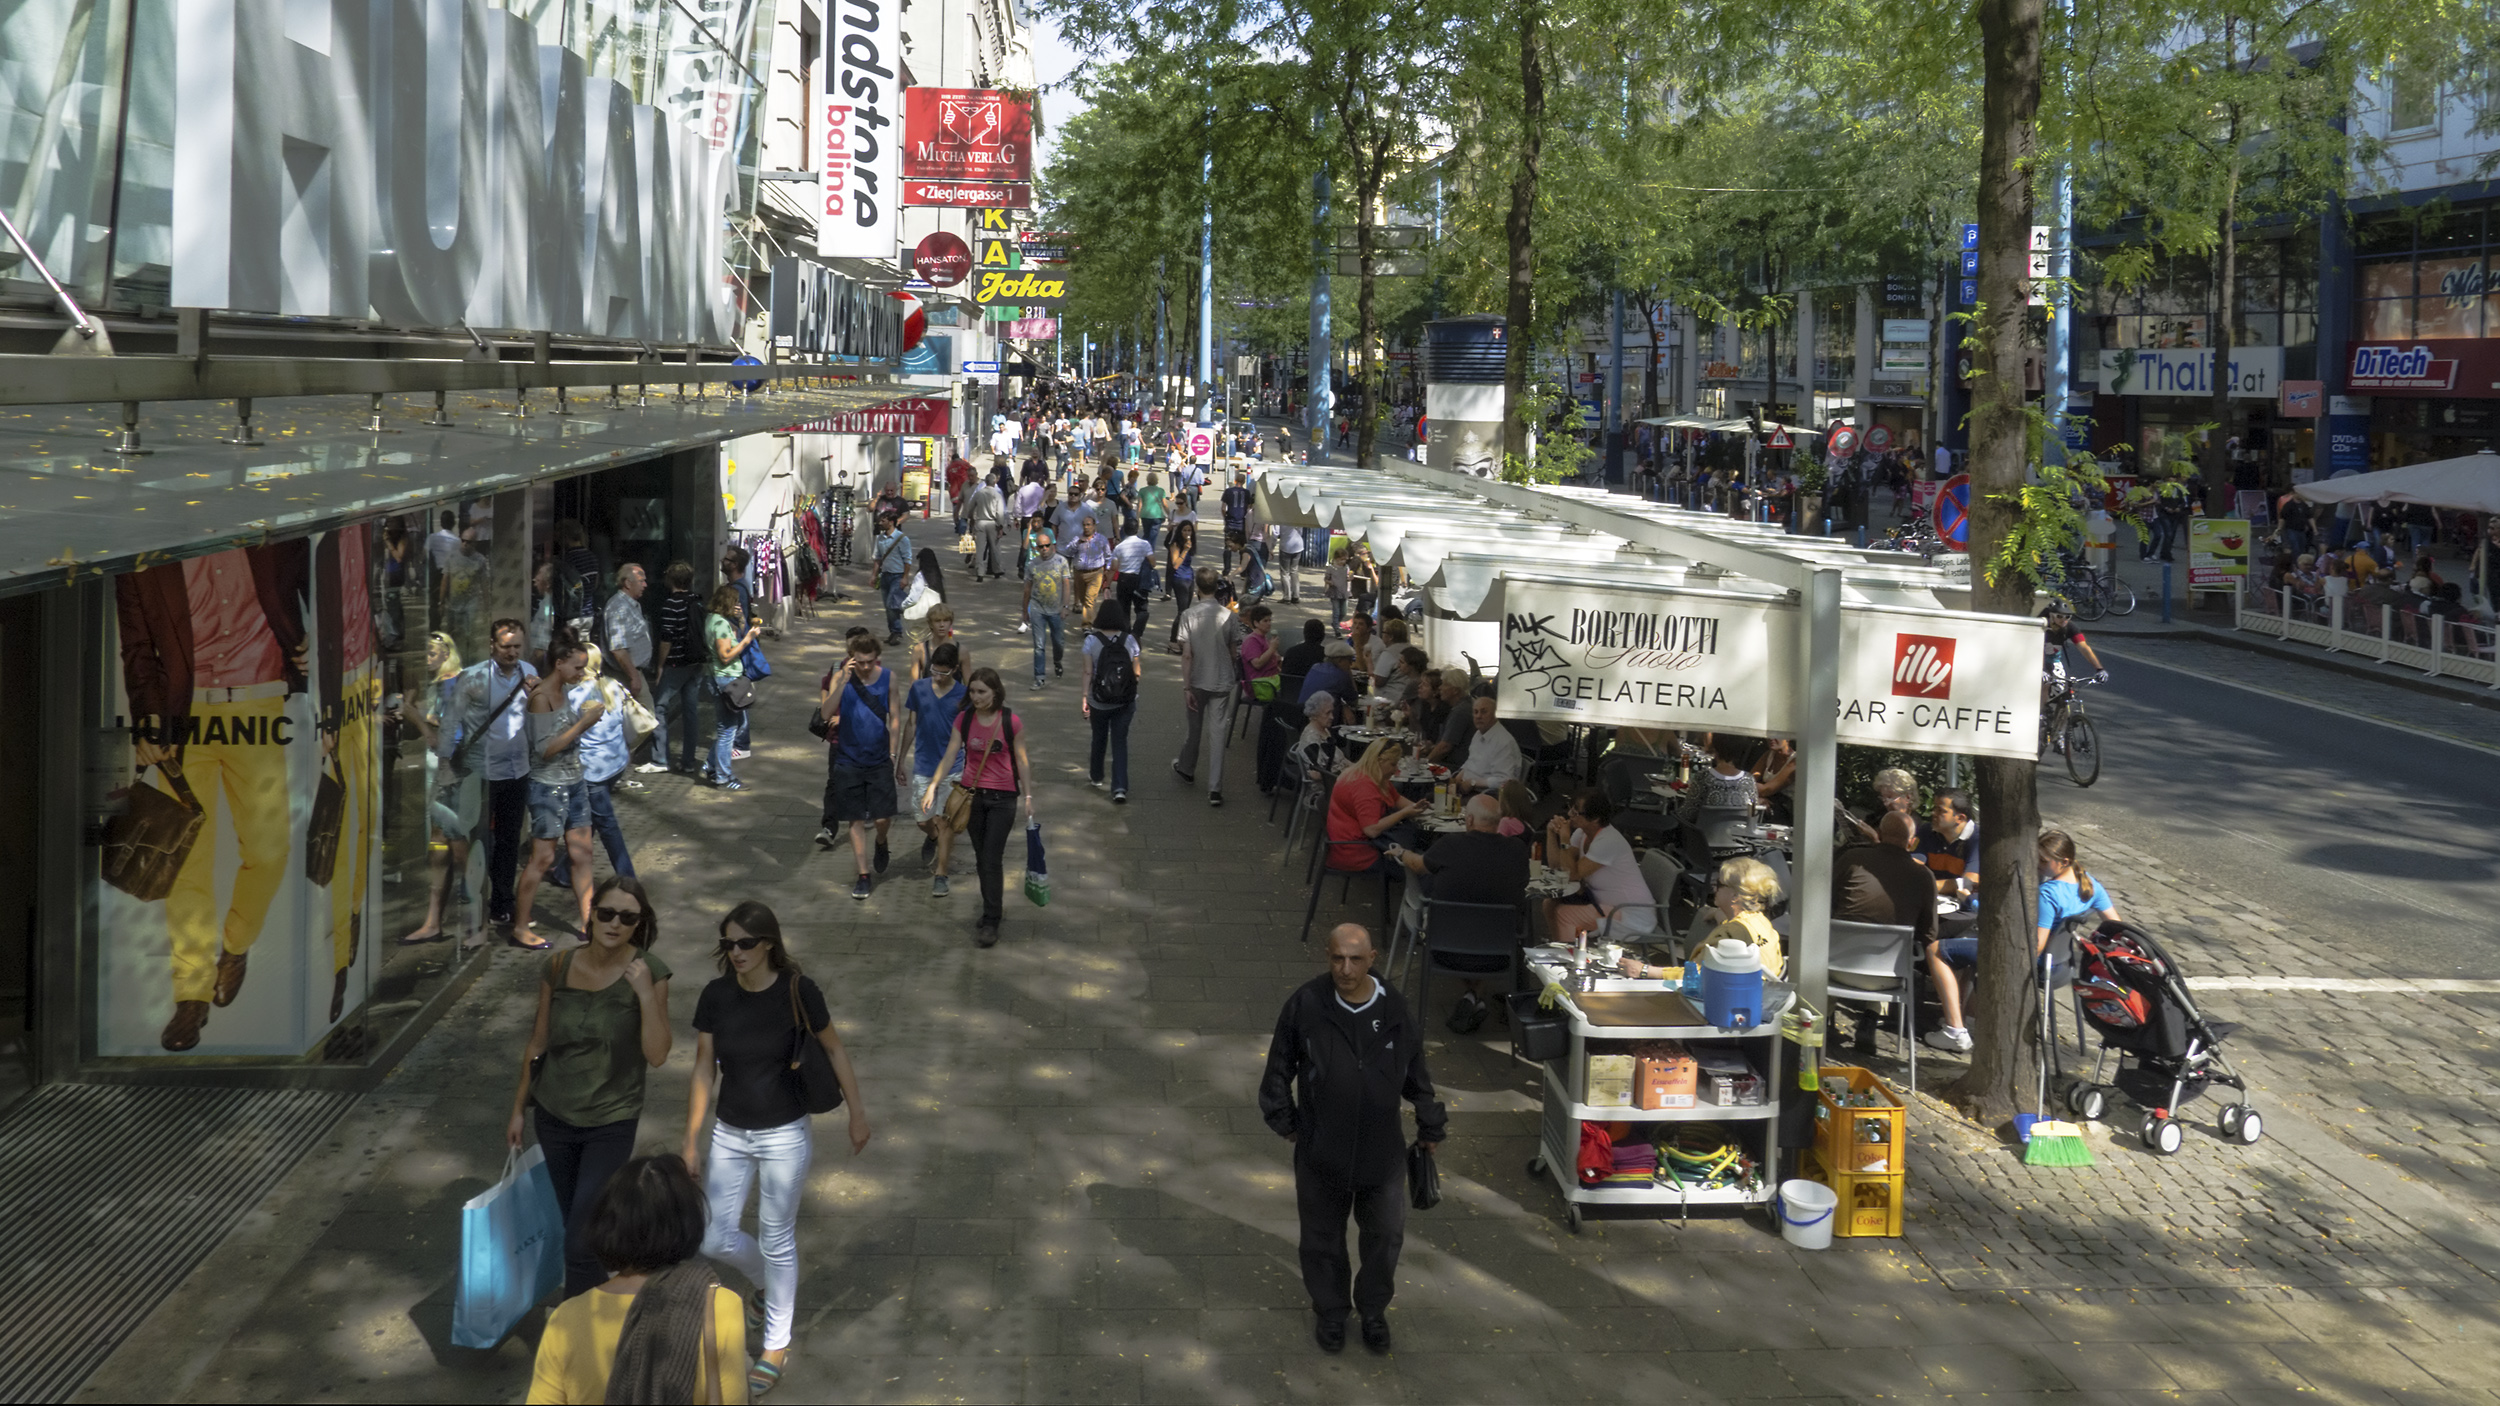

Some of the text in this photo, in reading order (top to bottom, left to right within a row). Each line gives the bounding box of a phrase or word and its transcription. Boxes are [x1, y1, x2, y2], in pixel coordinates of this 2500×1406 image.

[826, 105, 853, 215] balina
[927, 185, 1013, 203] Zieglergasse 1
[916, 255, 967, 265] HANSATON
[976, 272, 1065, 303] Joka
[2355, 349, 2428, 376] DiTech
[2332, 435, 2357, 444] DVDs
[2332, 443, 2351, 452] CDs
[1571, 607, 1720, 655] BORTOLOTTI
[1895, 643, 1952, 694] illy
[1551, 674, 1729, 711] GELATERIA
[115, 714, 294, 746] HUMANIC
[1912, 705, 2012, 735] CAFFÈ
[1651, 1078, 1688, 1086] Eiswaffeln
[1856, 1151, 1885, 1163] Coke
[1856, 1214, 1884, 1226] Coke
